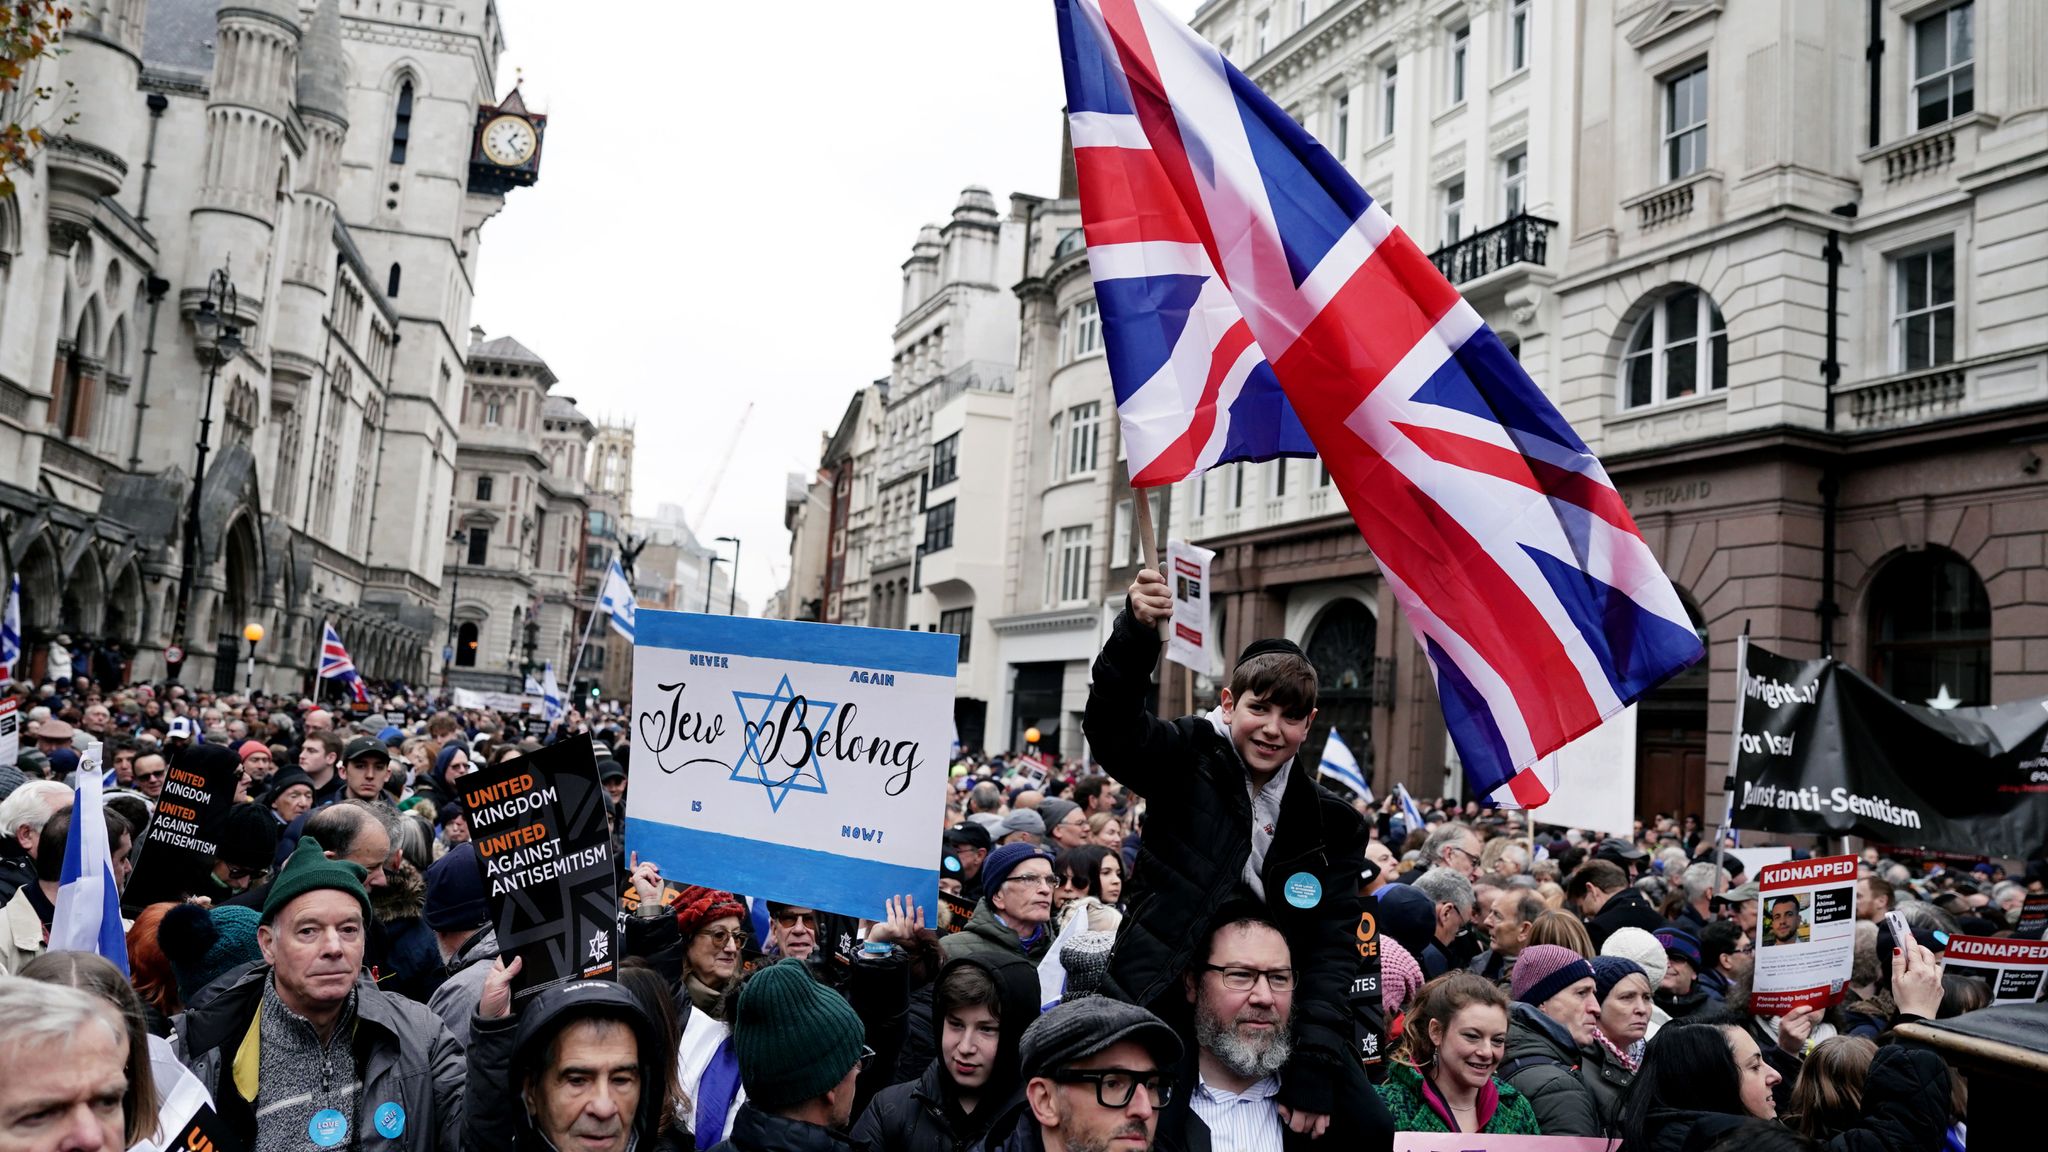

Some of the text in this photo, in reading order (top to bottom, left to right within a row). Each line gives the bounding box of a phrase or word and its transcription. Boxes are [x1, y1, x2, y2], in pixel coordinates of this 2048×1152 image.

[1644, 480, 1712, 507] STRAND
[689, 654, 895, 686] NEVER AGAIN
[640, 682, 925, 796] Jew Belong
[164, 780, 211, 804] KINGDOM
[170, 767, 205, 788] UNITED
[466, 774, 534, 809] UNITED
[160, 801, 196, 820] UNITED
[472, 786, 558, 829] KINGDOM
[691, 800, 884, 843] IS NOW!
[1777, 786, 1922, 829] anti-Semitism
[154, 815, 199, 835] AGAINST
[149, 828, 217, 855] ANTISEMITISM
[479, 823, 546, 857] UNITED
[486, 838, 561, 877] AGAINST
[492, 844, 607, 897] ANTISEMITISM
[1763, 861, 1854, 884] KIDNAPPED
[1950, 940, 2048, 959] KIDNAPPED
[317, 1120, 340, 1129] LOVE
